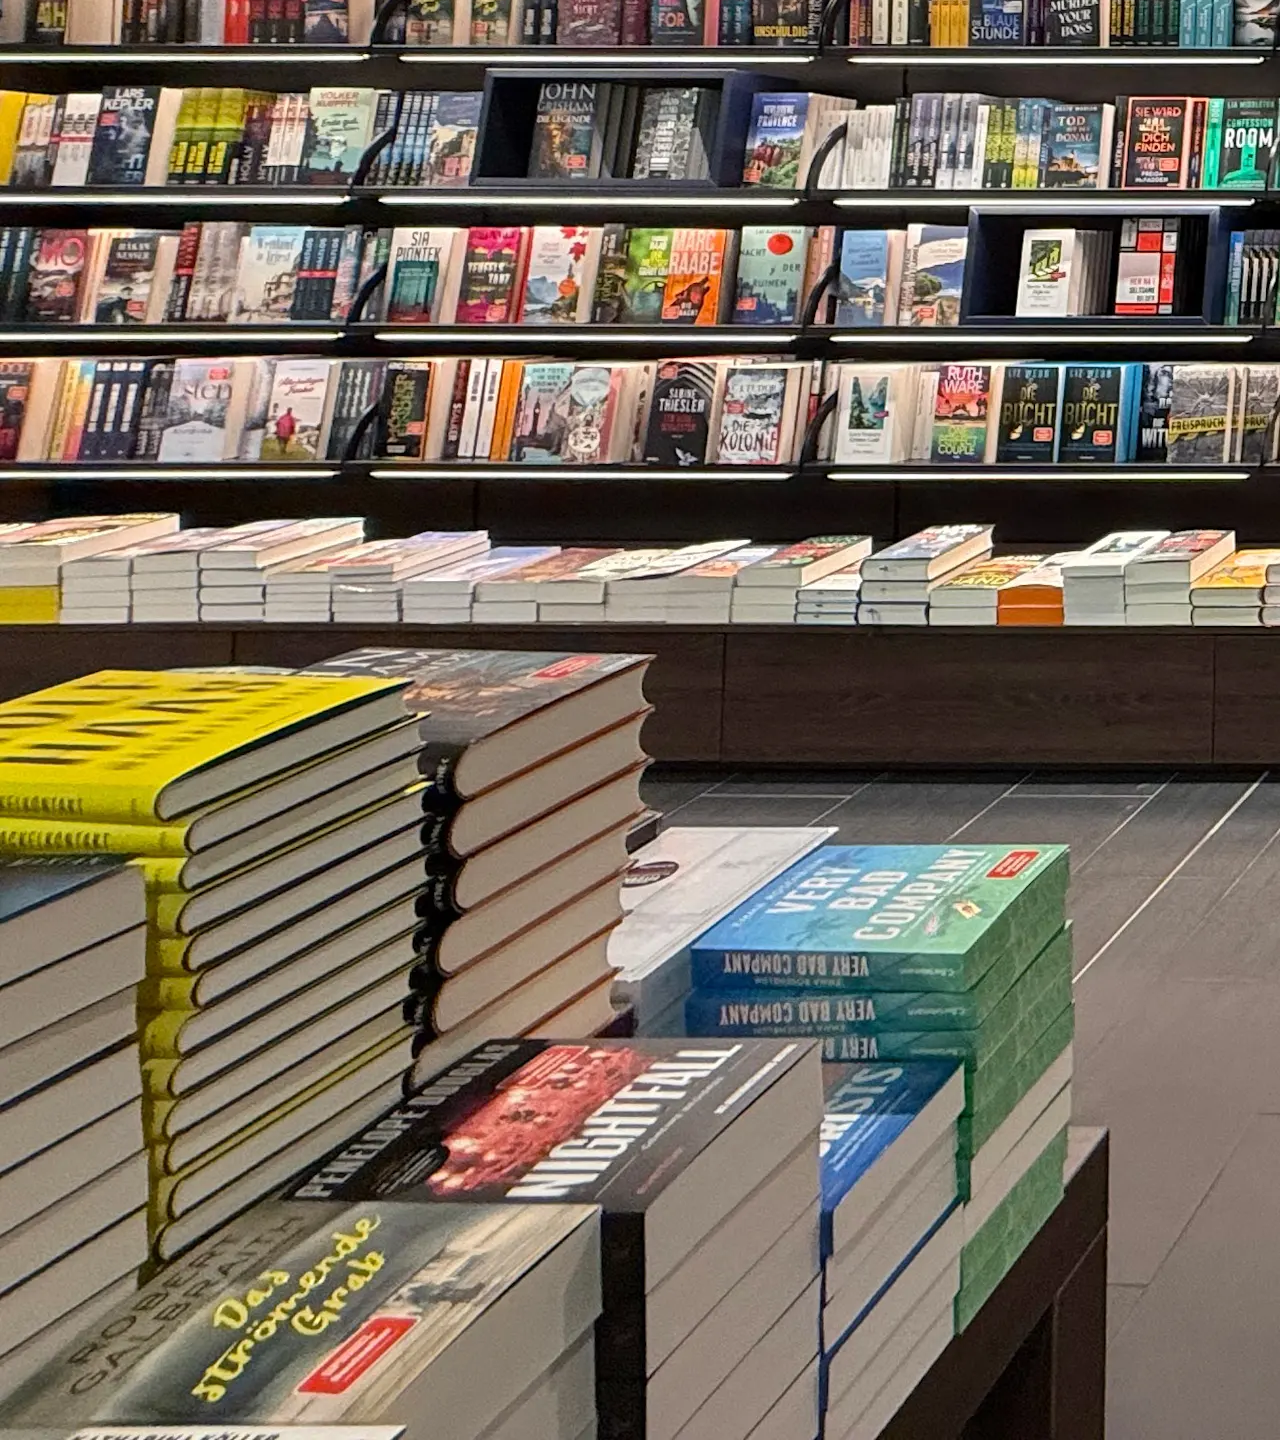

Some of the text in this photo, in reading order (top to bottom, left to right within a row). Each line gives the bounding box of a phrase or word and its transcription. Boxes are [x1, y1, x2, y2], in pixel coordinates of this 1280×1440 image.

[658, 12, 684, 28] FOR
[983, 14, 1020, 27] BLAUE
[1058, 10, 1091, 25] YOUR
[754, 25, 808, 38] UNSCHULDIG
[972, 26, 1020, 40] STUNDE
[1061, 22, 1093, 36] BOSS
[115, 88, 145, 100] LARS
[539, 84, 596, 101] JOHN
[103, 98, 154, 111] KEPLER
[538, 100, 594, 112] GRISHAM
[1135, 107, 1181, 117] SIE WIRD
[1058, 116, 1086, 126] TOD
[1226, 118, 1274, 128] CONFESSION
[1056, 133, 1093, 142] DONAU
[1142, 132, 1169, 143] DICH
[1224, 128, 1272, 148] ROOM
[1134, 141, 1175, 153] FINDEN
[411, 231, 429, 246] SIA
[676, 230, 704, 251] MARC
[396, 246, 442, 261] PIONTEK
[669, 251, 720, 274] RAABE
[948, 366, 981, 380] RUTH
[944, 379, 984, 393] WARE
[659, 398, 704, 413] THIESLER
[1002, 401, 1056, 424] BUCHT
[1065, 401, 1118, 424] BUCHT
[731, 421, 750, 431] DIE
[1170, 417, 1225, 432] FREISPRUCH
[720, 430, 778, 452] KOLONIE
[765, 865, 860, 915] VERY
[829, 870, 909, 911] BAD
[853, 849, 987, 941] COMPANY
[723, 952, 869, 977] VERY BAD COMPANY
[720, 998, 876, 1026] VERY BAD COMPANY
[841, 1036, 878, 1060] VERY
[505, 1043, 744, 1198] NIGHTFALL
[213, 1269, 291, 1330] Das
[291, 1250, 385, 1336] Grab
[191, 1215, 381, 1402] strömende
